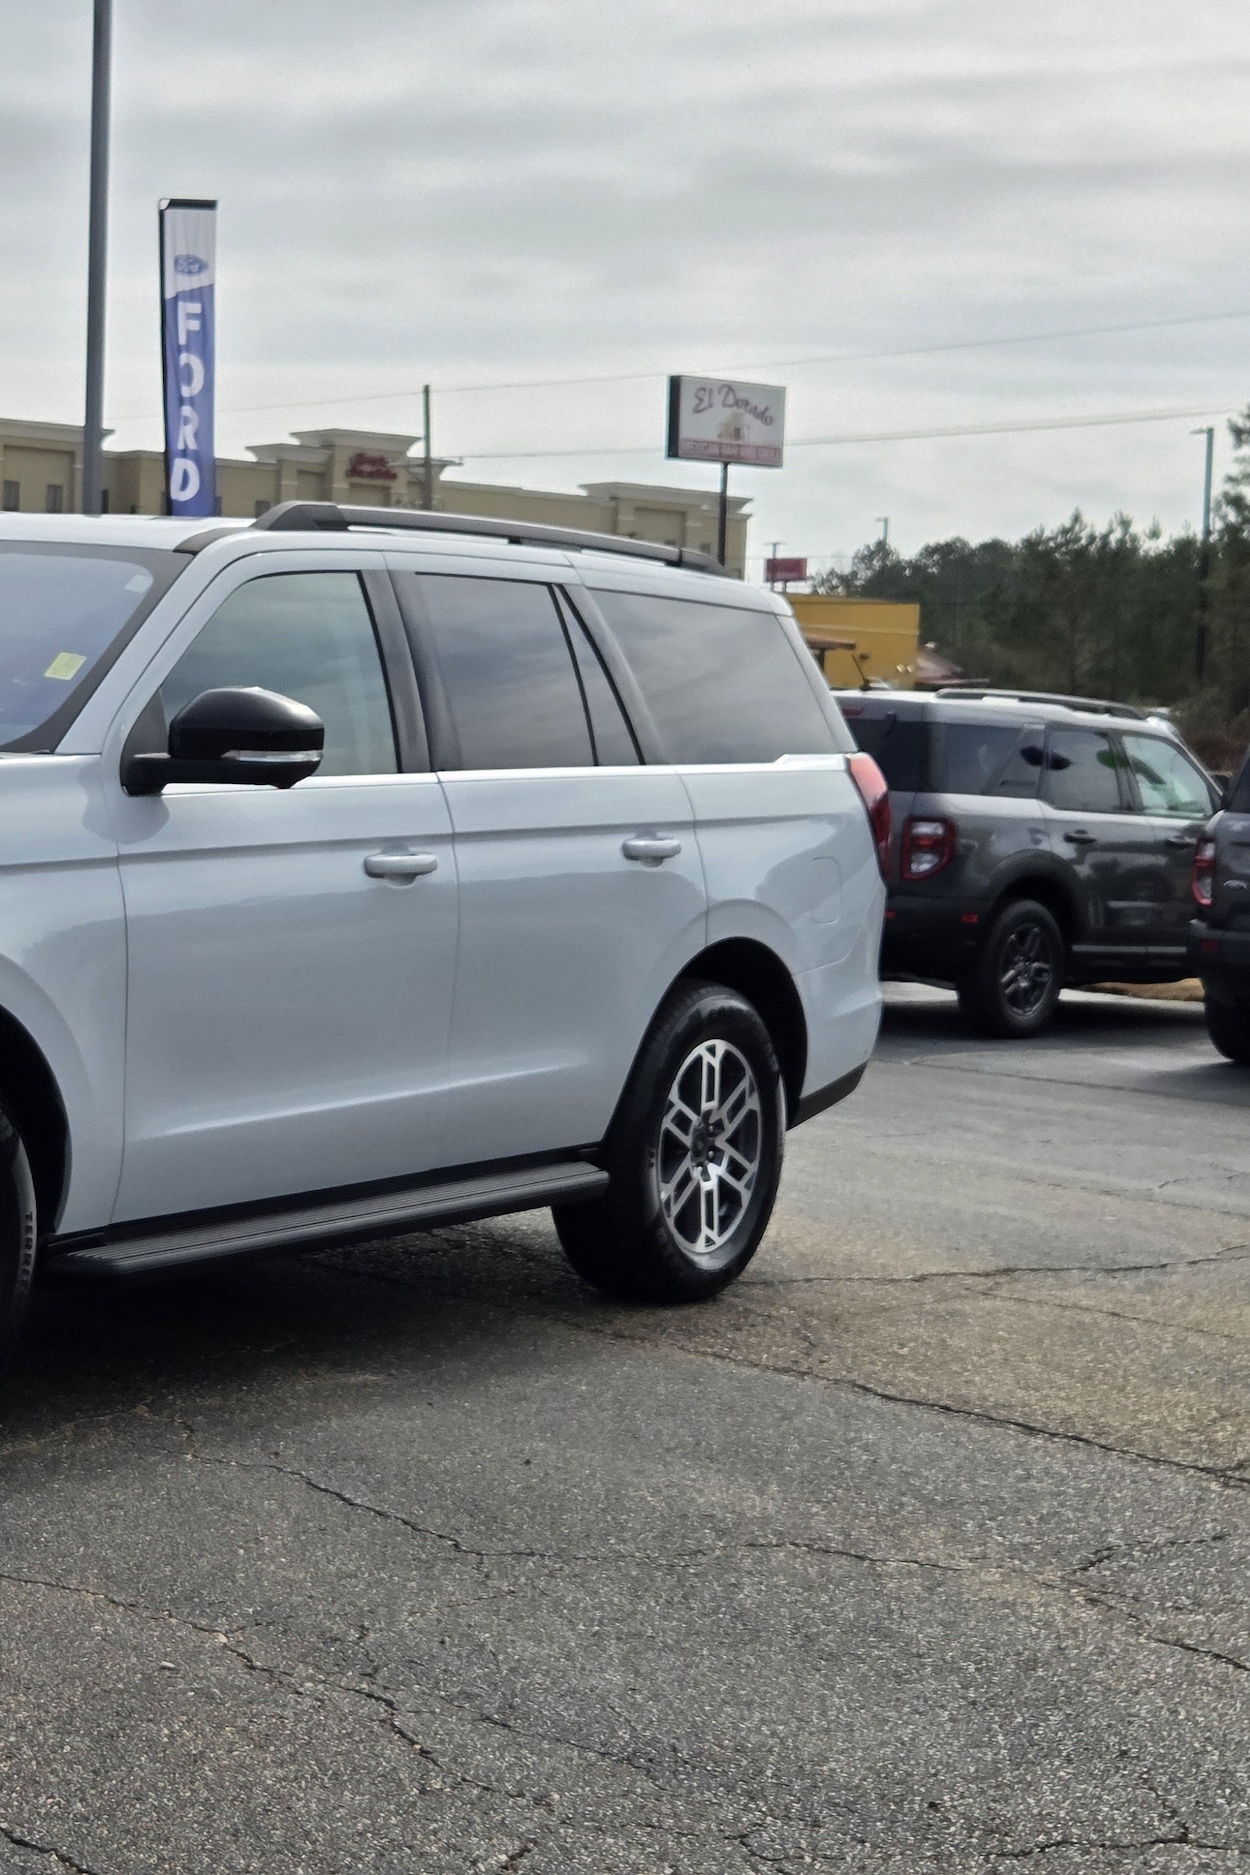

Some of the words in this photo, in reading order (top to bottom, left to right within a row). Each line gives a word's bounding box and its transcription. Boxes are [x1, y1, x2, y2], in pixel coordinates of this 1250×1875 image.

[170, 302, 204, 501] FORD
[692, 386, 714, 414] El
[718, 384, 774, 426] Dorado
